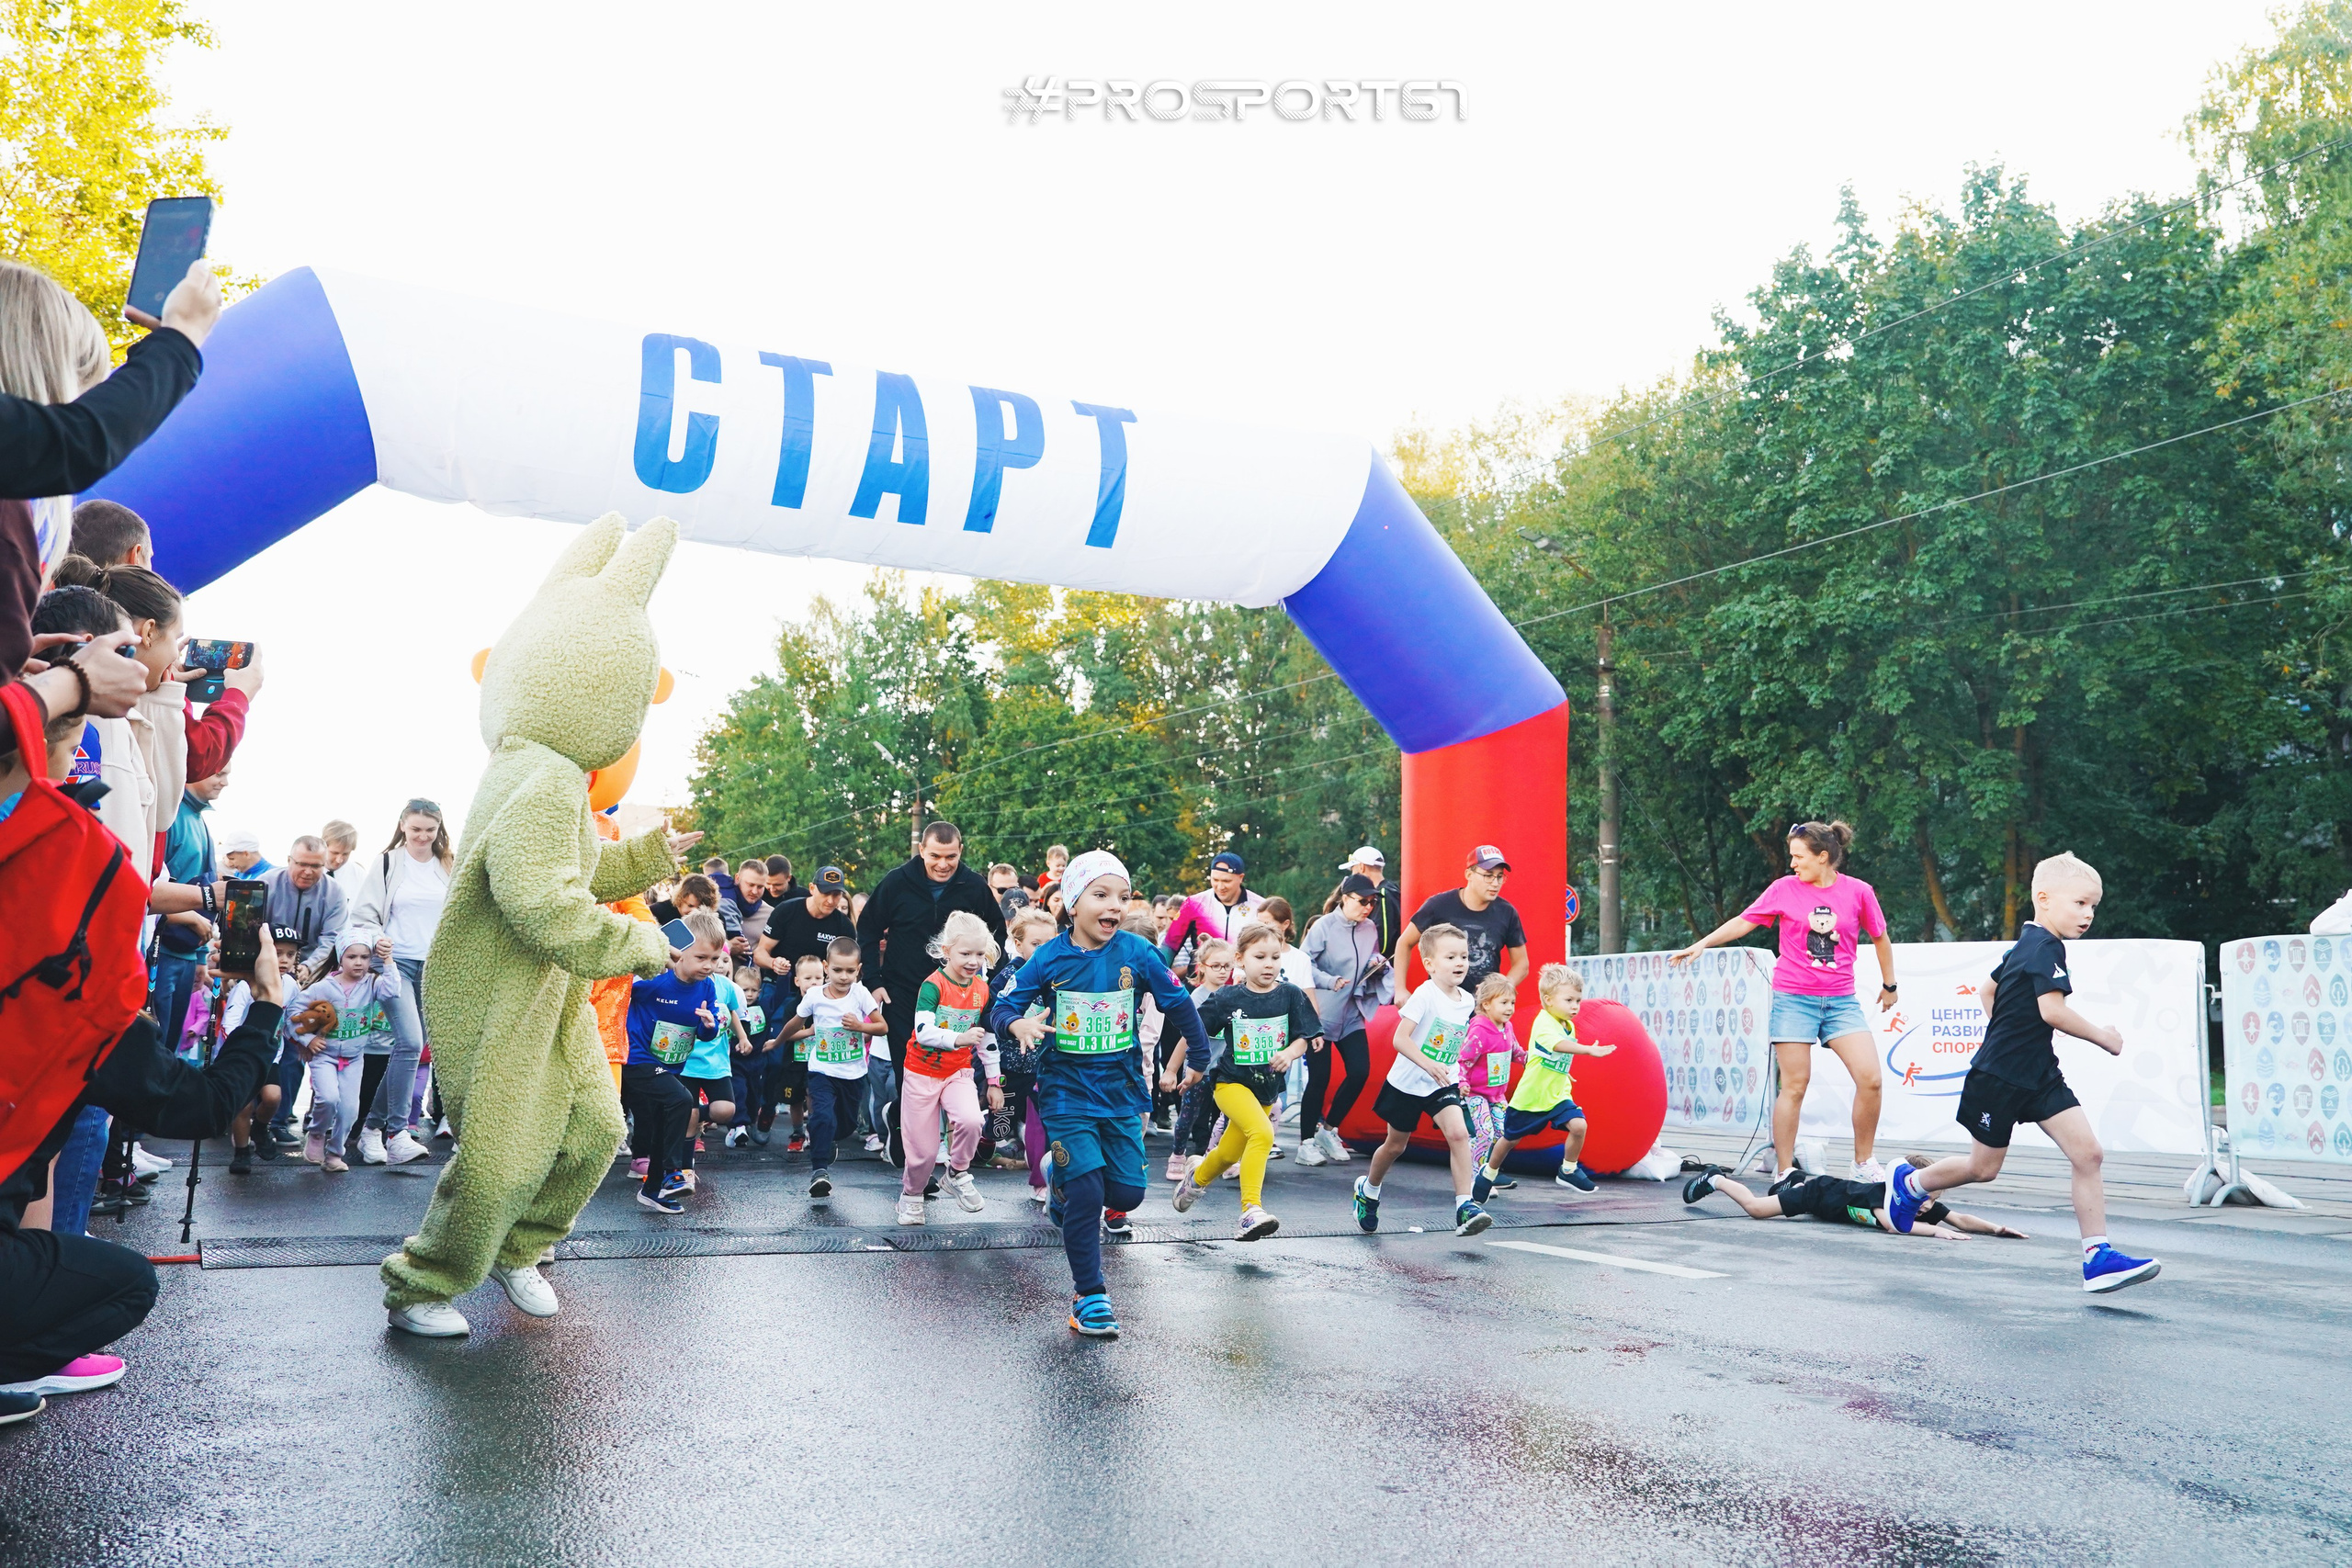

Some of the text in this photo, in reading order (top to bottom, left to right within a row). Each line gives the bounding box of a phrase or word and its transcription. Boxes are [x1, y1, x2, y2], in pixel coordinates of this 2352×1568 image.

[633, 333, 1137, 548] СТАРТ
[275, 928, 298, 939] BOY
[1932, 1009, 1983, 1022] ЦЕНТР
[342, 1020, 357, 1029] 378
[1086, 1016, 1112, 1033] 365
[1932, 1025, 1987, 1037] РАЗВИ
[831, 1040, 847, 1051] 368
[1102, 1034, 1116, 1050] КМ
[1254, 1035, 1273, 1049] 358
[784, 1087, 792, 1099] 15
